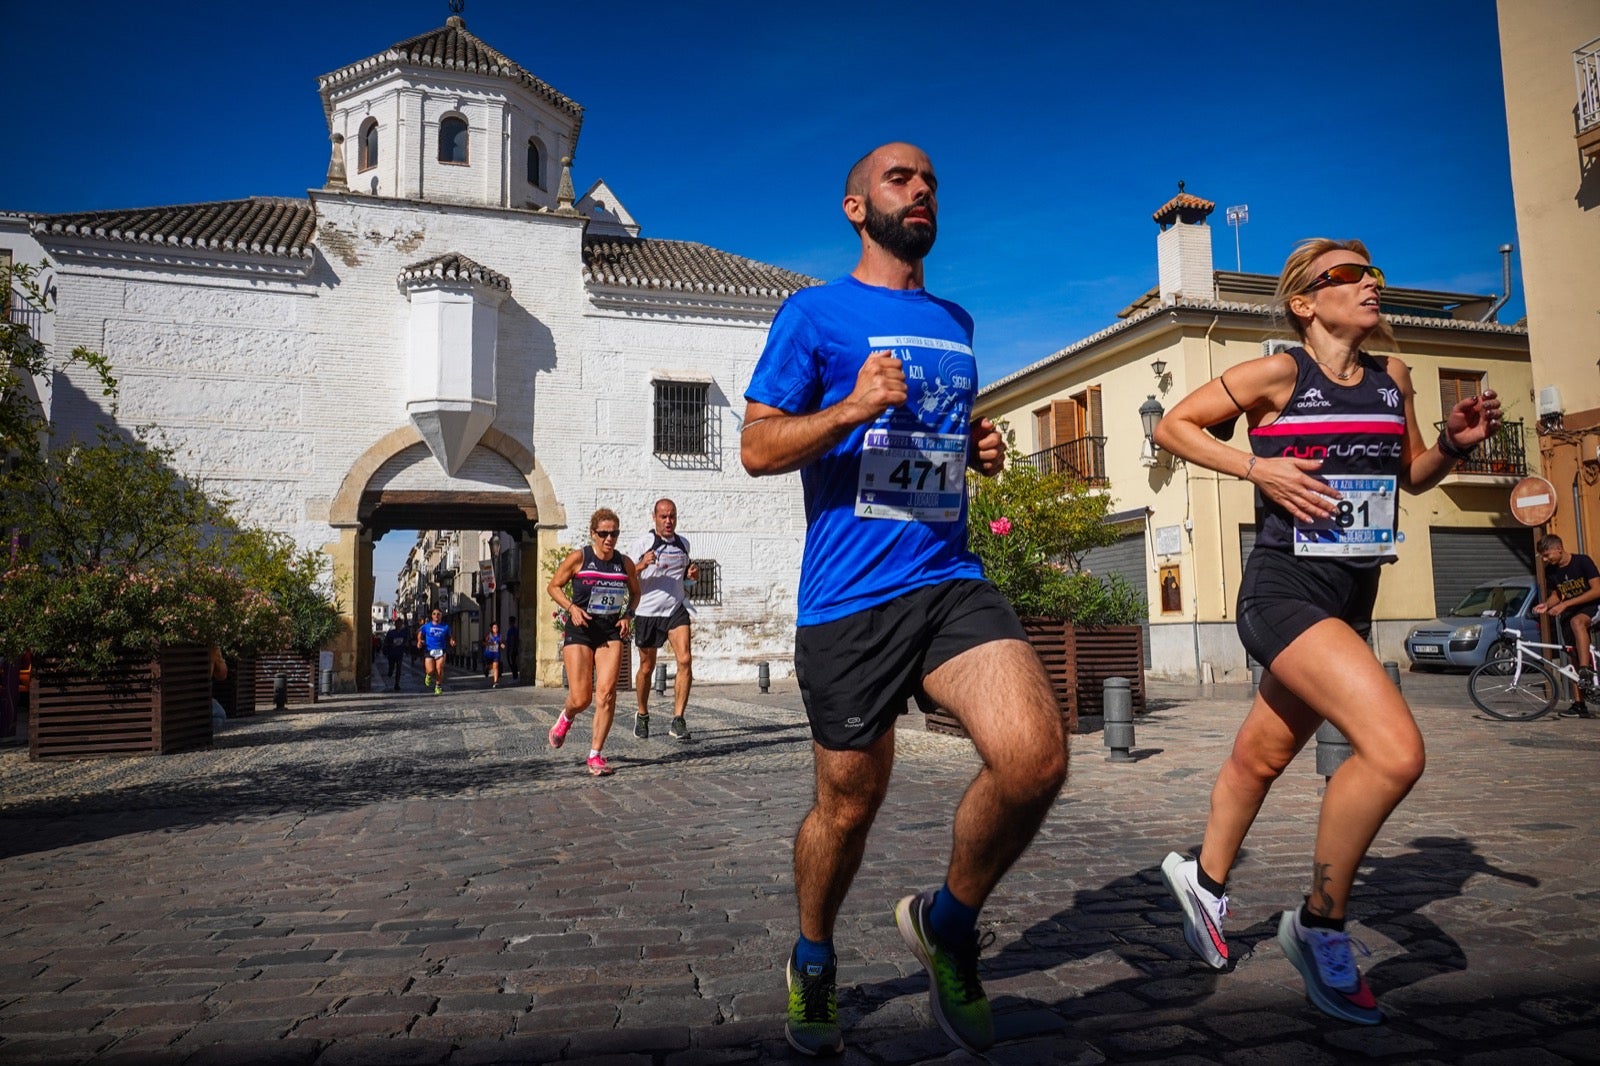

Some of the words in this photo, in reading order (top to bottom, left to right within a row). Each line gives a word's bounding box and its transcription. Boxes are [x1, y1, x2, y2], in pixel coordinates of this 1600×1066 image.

[901, 348, 912, 361] LA
[909, 365, 925, 380] AZUL
[1297, 400, 1332, 408] austral
[873, 436, 881, 445] VI
[925, 439, 936, 450] POR
[889, 459, 947, 491] 471
[1340, 479, 1354, 490] AZUL
[1336, 500, 1369, 528] 81
[601, 596, 616, 606] 83
